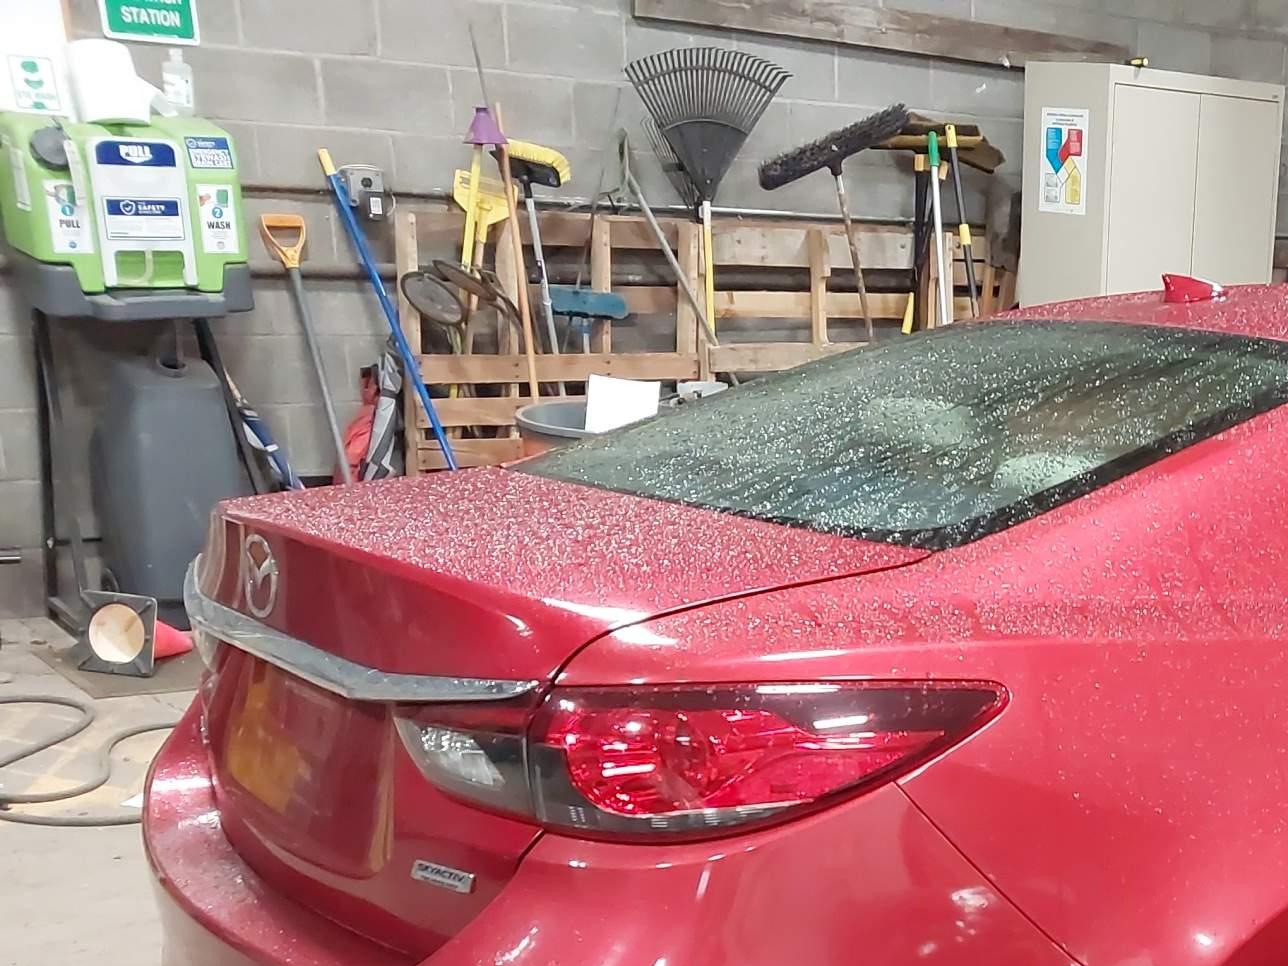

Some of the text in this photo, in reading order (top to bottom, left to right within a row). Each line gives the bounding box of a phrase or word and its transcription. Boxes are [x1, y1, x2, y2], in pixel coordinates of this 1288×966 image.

[120, 5, 181, 28] STATION
[58, 219, 81, 229] PULL
[206, 221, 231, 230] WASH
